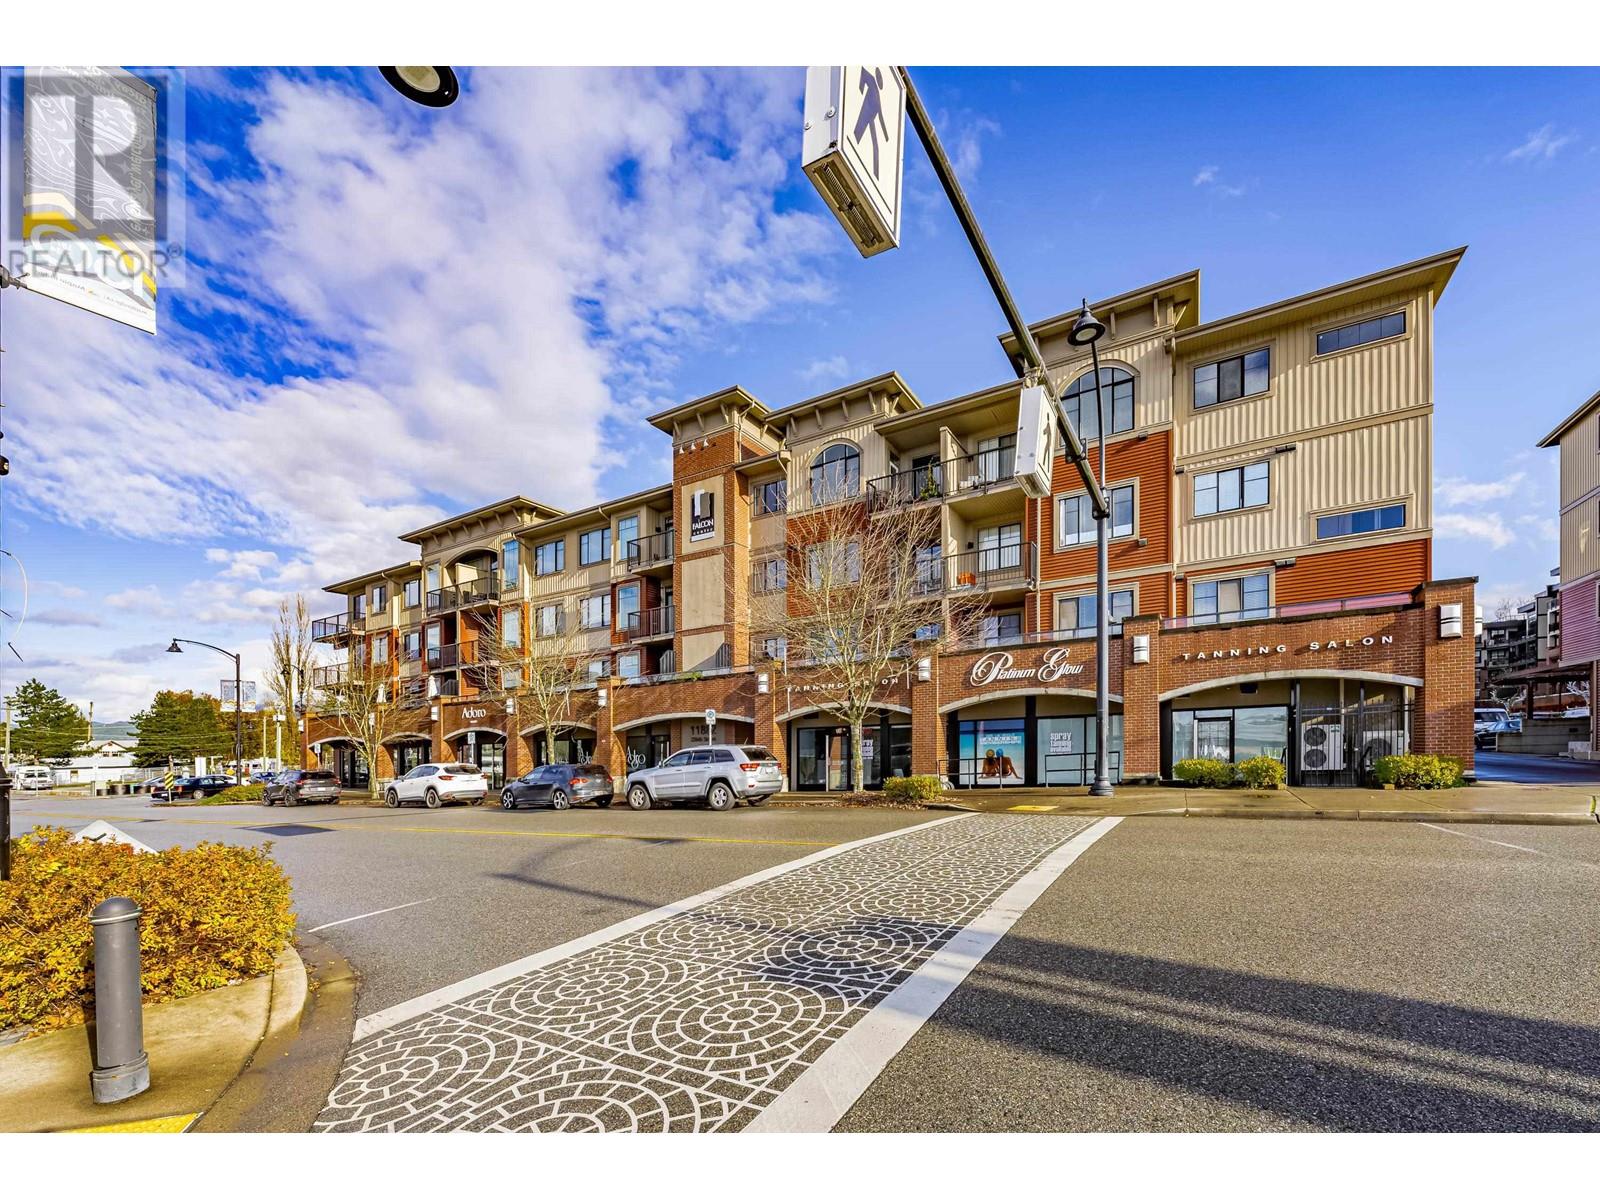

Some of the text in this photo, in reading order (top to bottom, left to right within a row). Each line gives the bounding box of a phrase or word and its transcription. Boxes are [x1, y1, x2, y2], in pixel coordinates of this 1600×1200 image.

[692, 518, 714, 530] FALCON
[1182, 635, 1393, 661] TANNING SALON
[970, 647, 1084, 687] Platinum Glow
[461, 706, 487, 720] Adoro
[1050, 732, 1072, 741] spray
